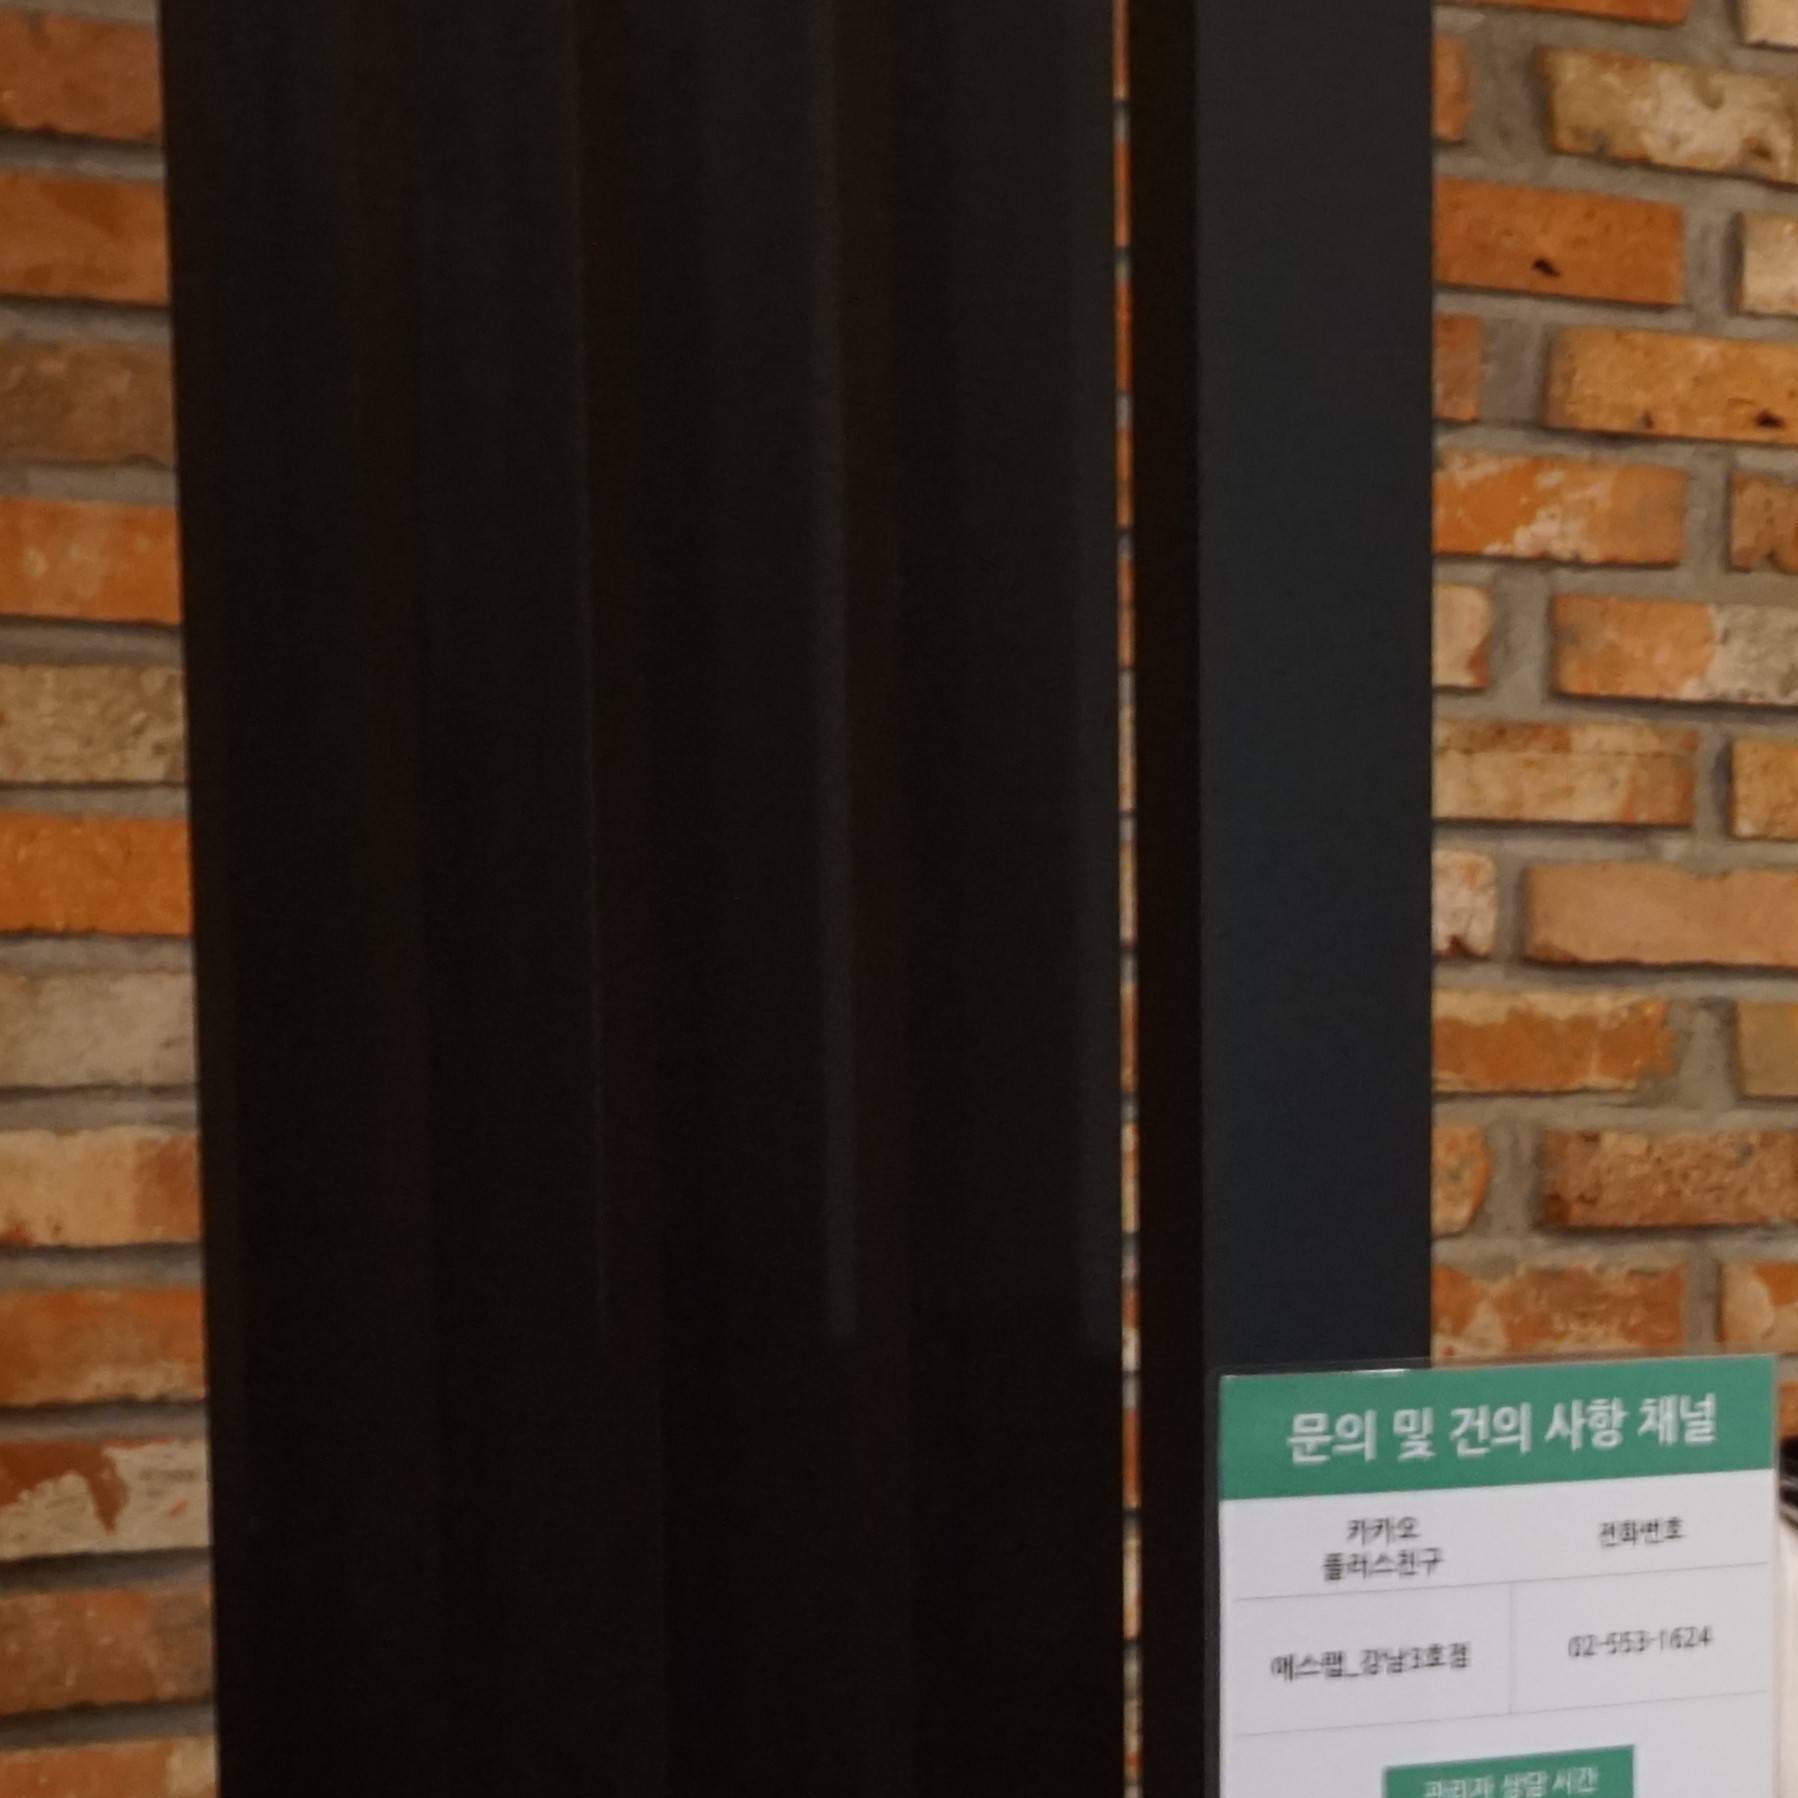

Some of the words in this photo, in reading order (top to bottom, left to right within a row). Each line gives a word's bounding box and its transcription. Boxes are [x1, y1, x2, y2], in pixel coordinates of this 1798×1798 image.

[1288, 1409, 1378, 1464] 문의
[1393, 1407, 1436, 1461] 및
[1449, 1402, 1532, 1458] 건의
[1544, 1398, 1626, 1450] 사항
[1637, 1393, 1717, 1447] 채널
[1346, 1516, 1422, 1546] 카카오
[1598, 1517, 1686, 1549] 전화번호
[1321, 1549, 1444, 1583] 플러스친구
[1567, 1625, 1714, 1660] 02-553-1624
[1553, 1765, 1600, 1796] 시간
